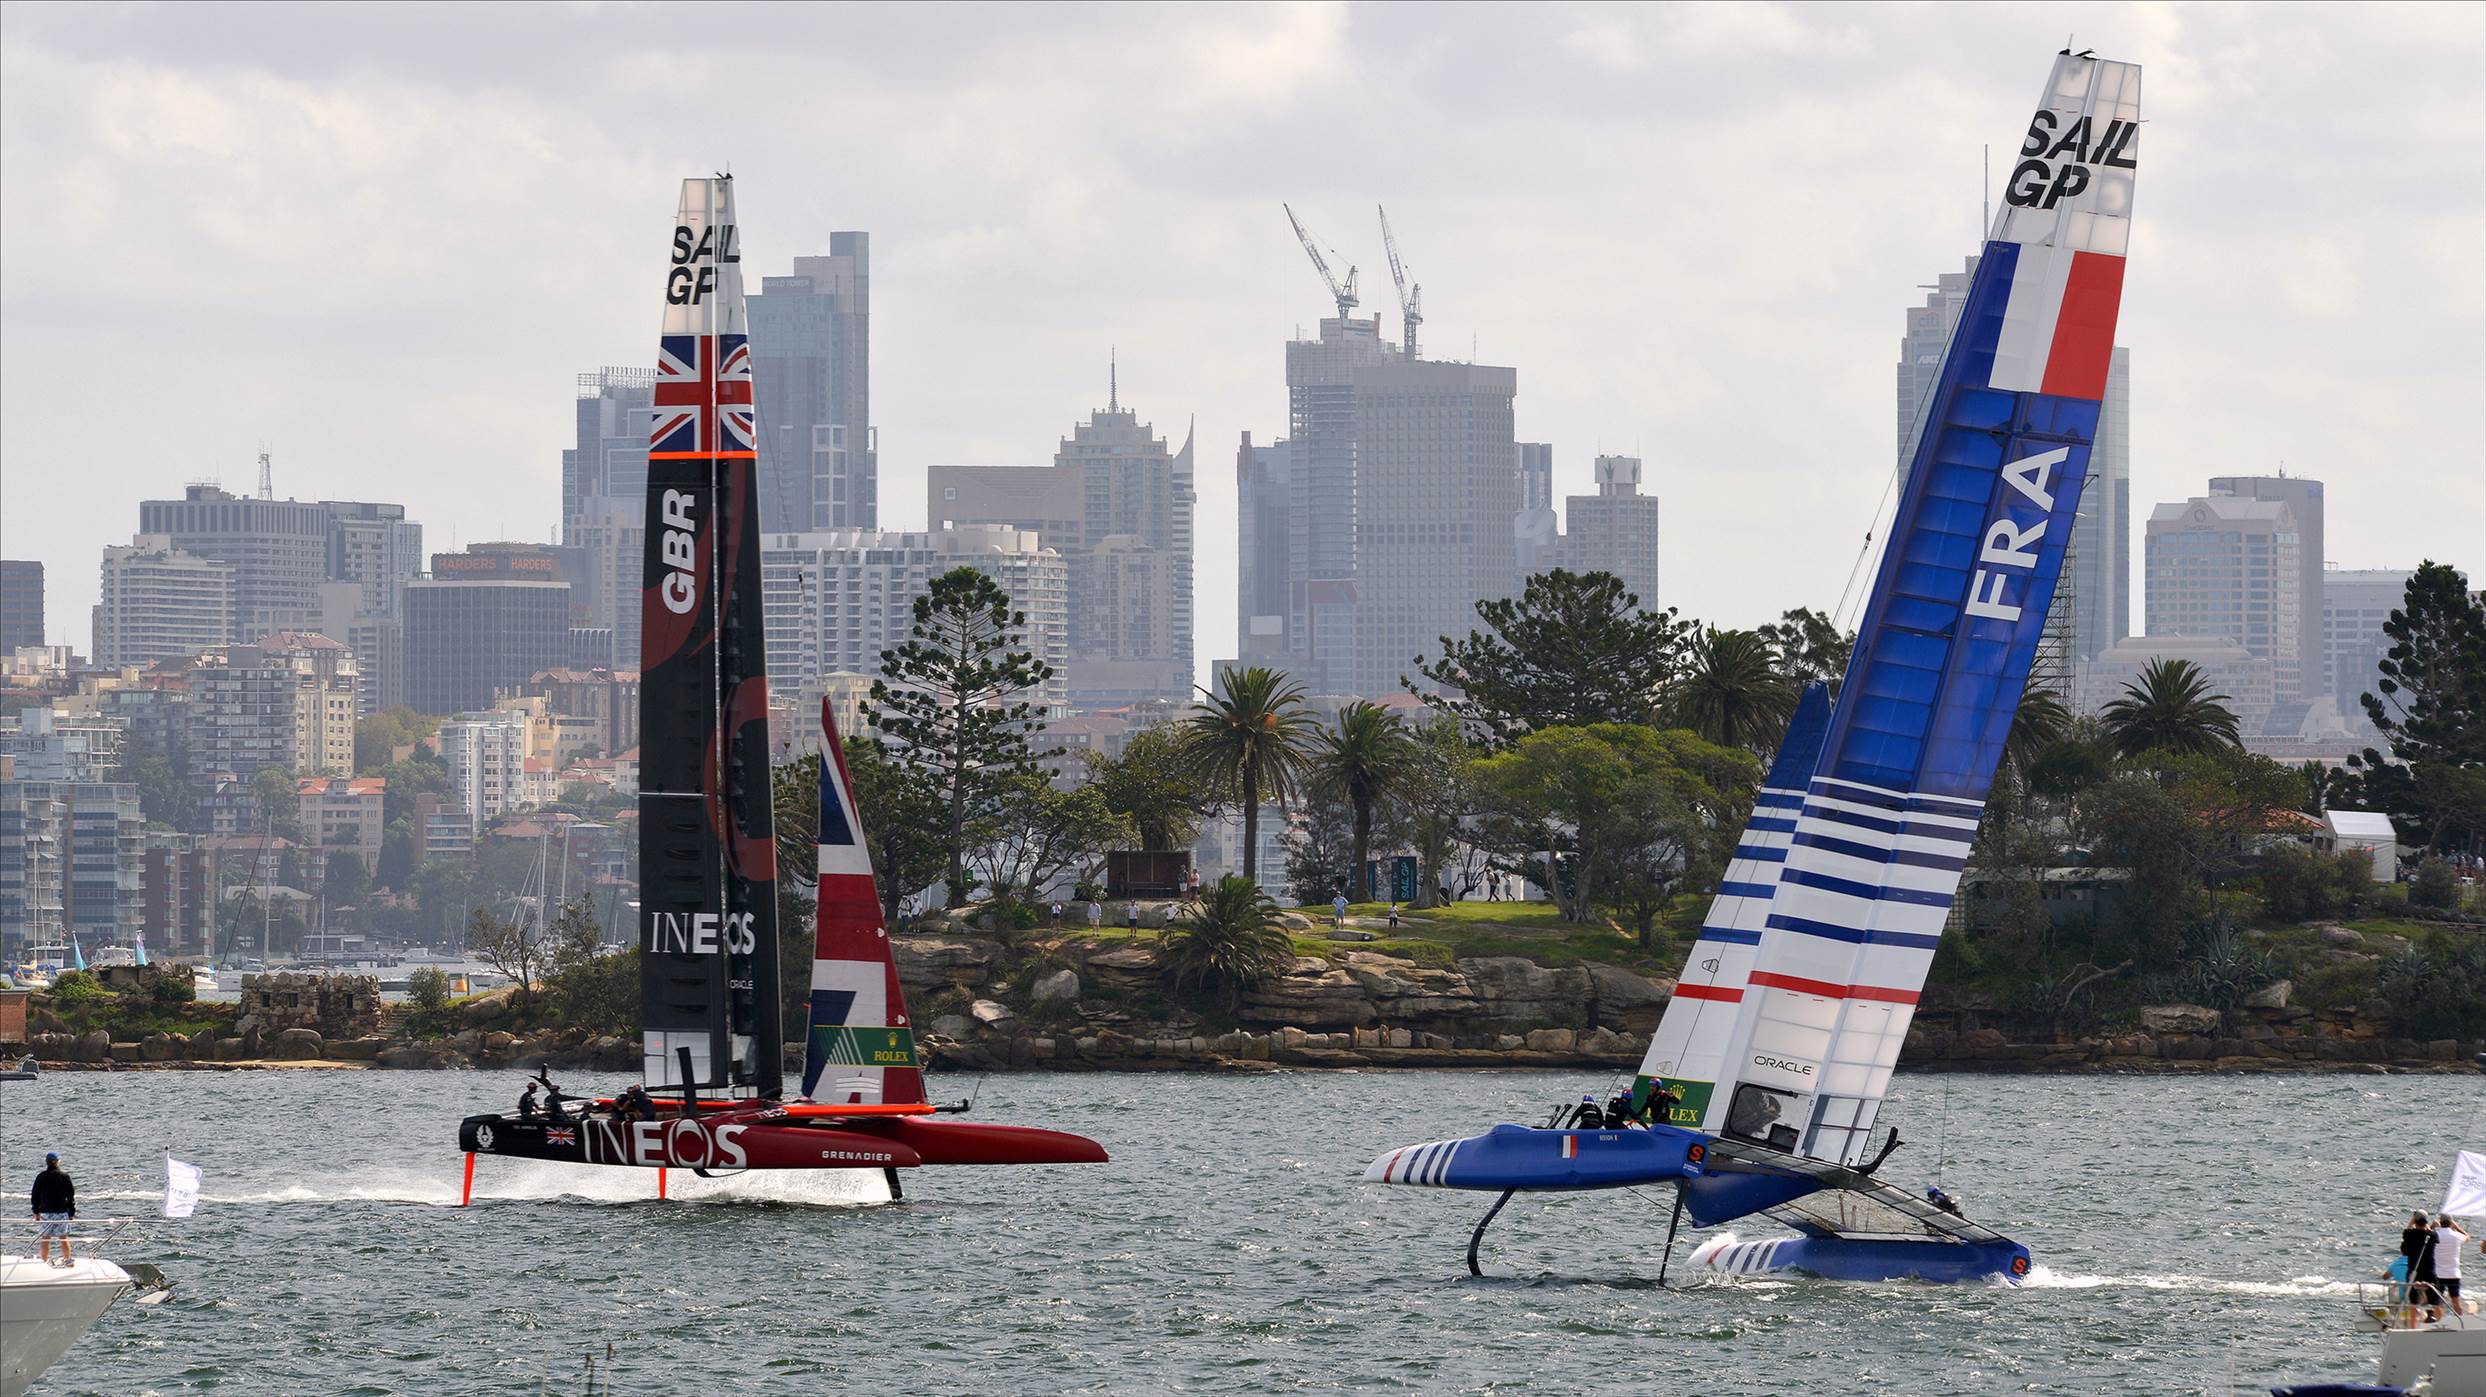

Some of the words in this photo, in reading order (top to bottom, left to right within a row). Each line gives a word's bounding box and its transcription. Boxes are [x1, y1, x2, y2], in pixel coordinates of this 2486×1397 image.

[2020, 109, 2139, 170] SAIL
[2005, 159, 2092, 210] GP
[671, 224, 741, 265] SAIL
[665, 265, 719, 306] GP
[661, 488, 696, 615] GBR
[1964, 446, 2070, 622] FRA
[438, 558, 497, 571] HARDERS
[511, 558, 552, 571] HARDERS
[649, 911, 756, 955] INEOS
[873, 1050, 910, 1062] ROLEX
[1754, 1055, 1812, 1076] ORACLE
[1646, 1106, 1699, 1122] LEX
[581, 1117, 750, 1169] INEOS
[821, 1150, 893, 1162] GRENADIER
